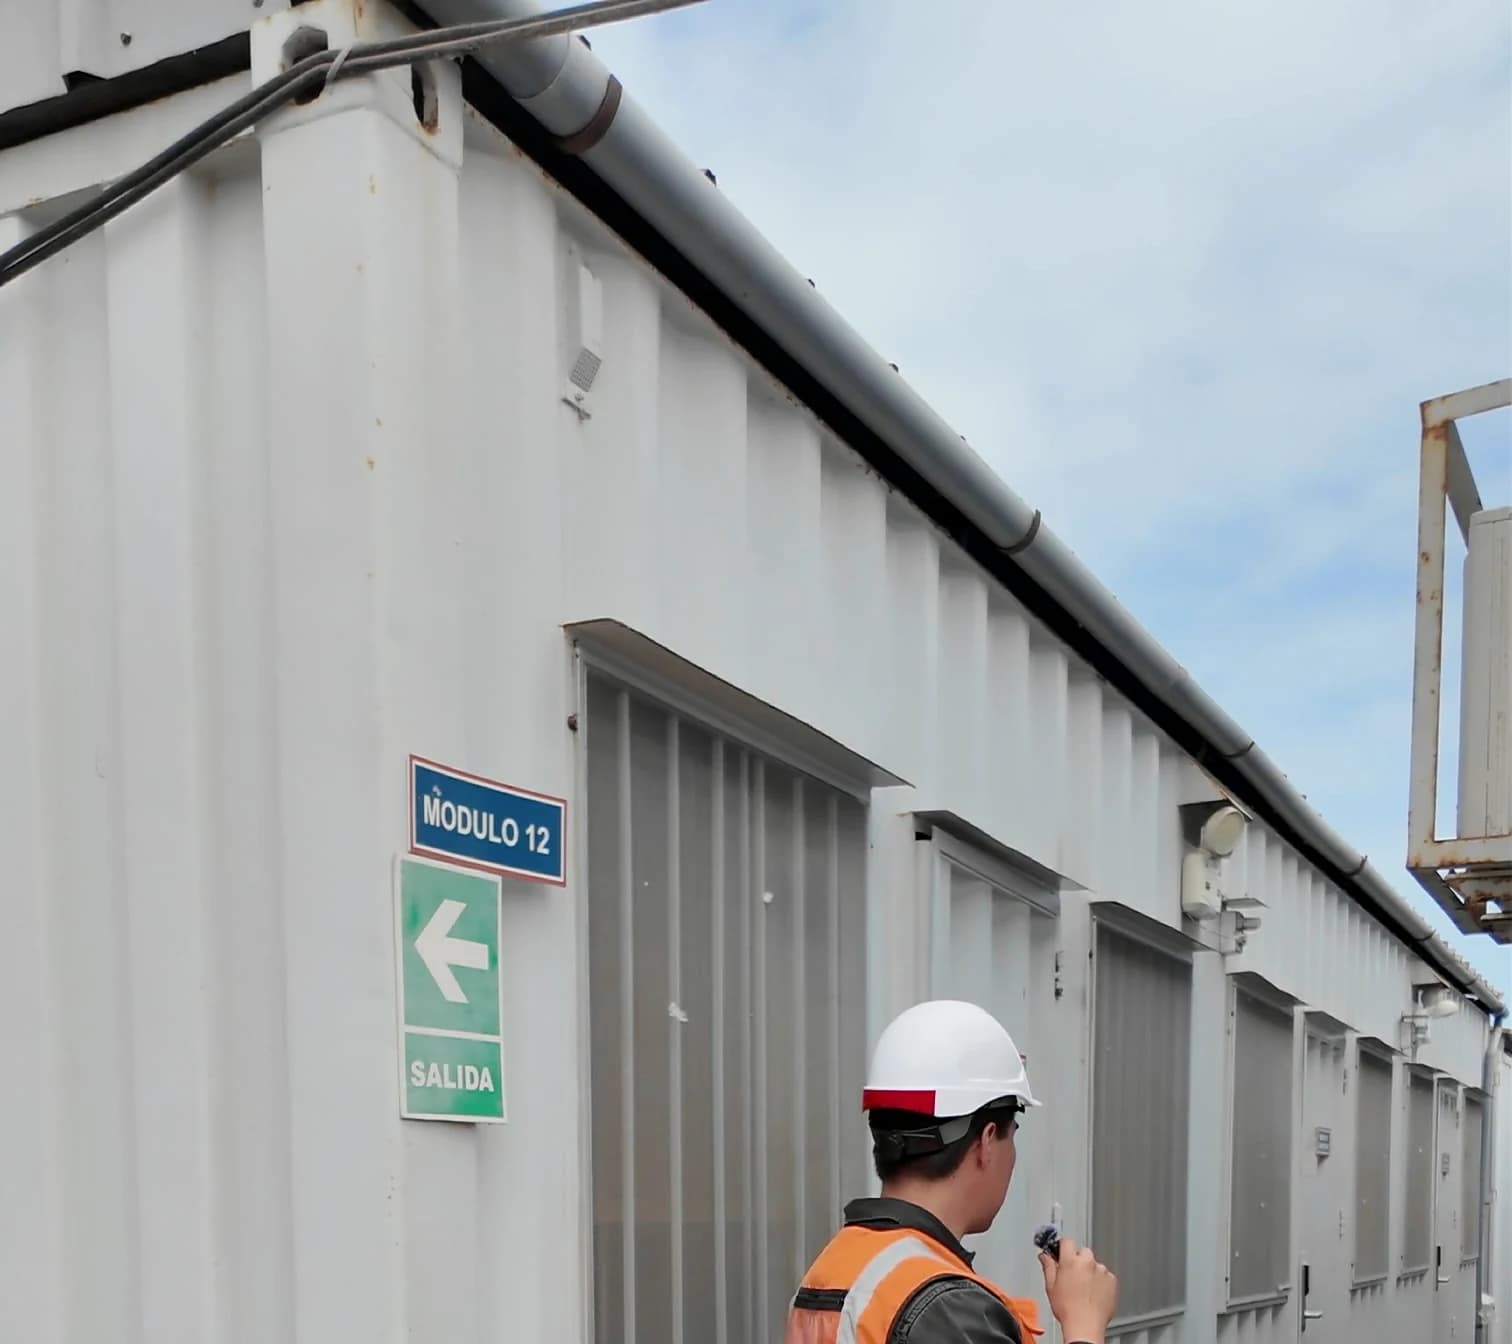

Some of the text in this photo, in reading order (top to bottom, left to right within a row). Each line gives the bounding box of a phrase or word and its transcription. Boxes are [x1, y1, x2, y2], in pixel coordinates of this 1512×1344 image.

[423, 794, 550, 855] MODULO 12
[411, 1060, 495, 1092] SALIDA
